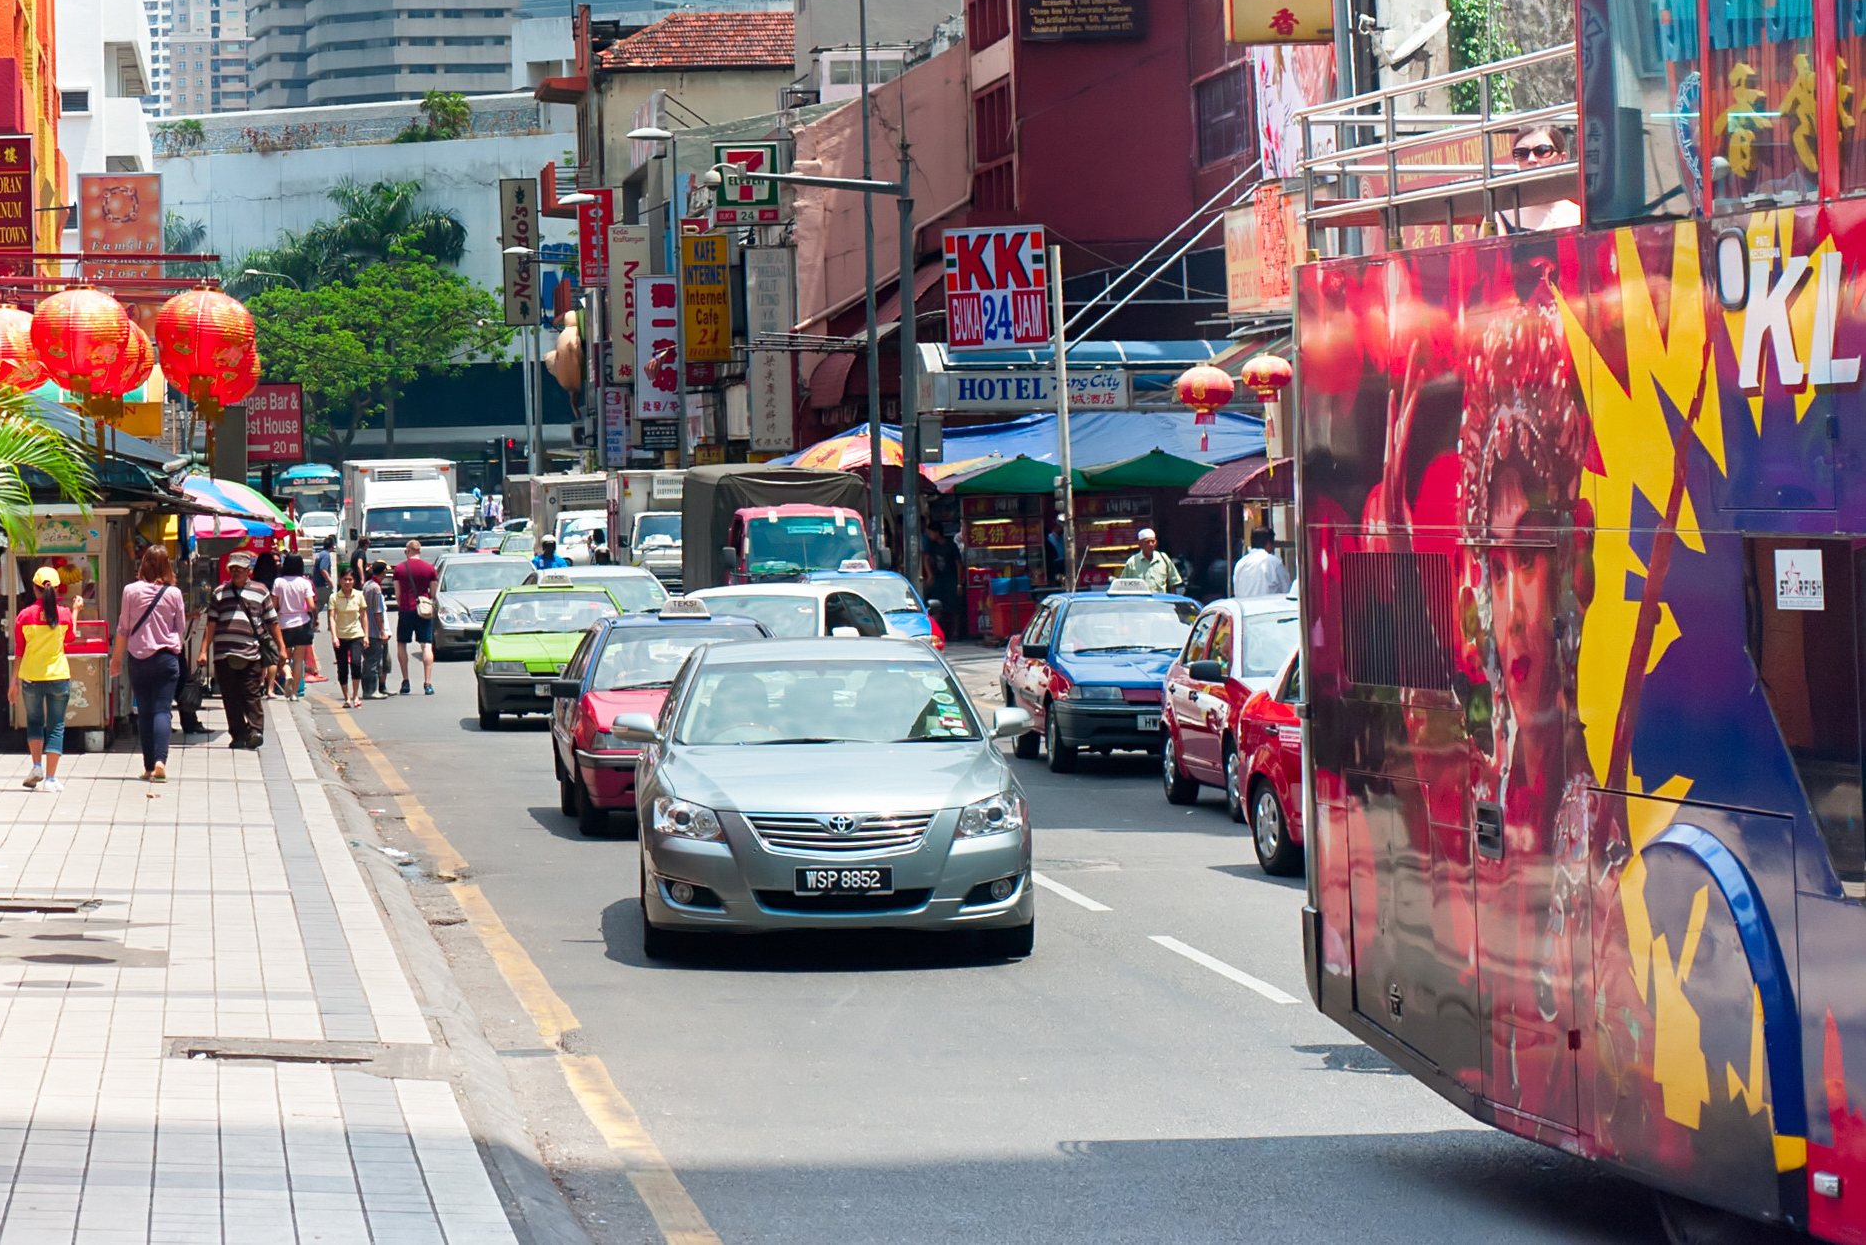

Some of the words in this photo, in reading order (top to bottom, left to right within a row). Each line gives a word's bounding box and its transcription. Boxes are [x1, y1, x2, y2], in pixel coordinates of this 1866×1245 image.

[741, 210, 755, 221] 24
[91, 239, 155, 252] Family
[694, 240, 717, 261] KAFE
[957, 232, 1032, 291] KK
[96, 267, 149, 279] Store
[685, 264, 727, 286] INTERNET
[686, 288, 727, 306] Internet
[695, 308, 720, 326] Cafe
[952, 297, 983, 342] BUKA
[984, 294, 1013, 341] 24
[1015, 294, 1044, 339] JAM
[1738, 251, 1862, 389] KL
[697, 328, 720, 346] 24
[957, 377, 1048, 401] HOTEL
[1089, 373, 1121, 391] City
[269, 392, 289, 411] Bar
[290, 392, 299, 410] &
[1066, 392, 1116, 405] 城酒店
[263, 417, 299, 435] House
[273, 441, 287, 454] 20
[289, 443, 299, 454] m
[672, 599, 698, 607] TEKSI
[806, 870, 838, 888] WSP
[841, 870, 881, 888] 8852
